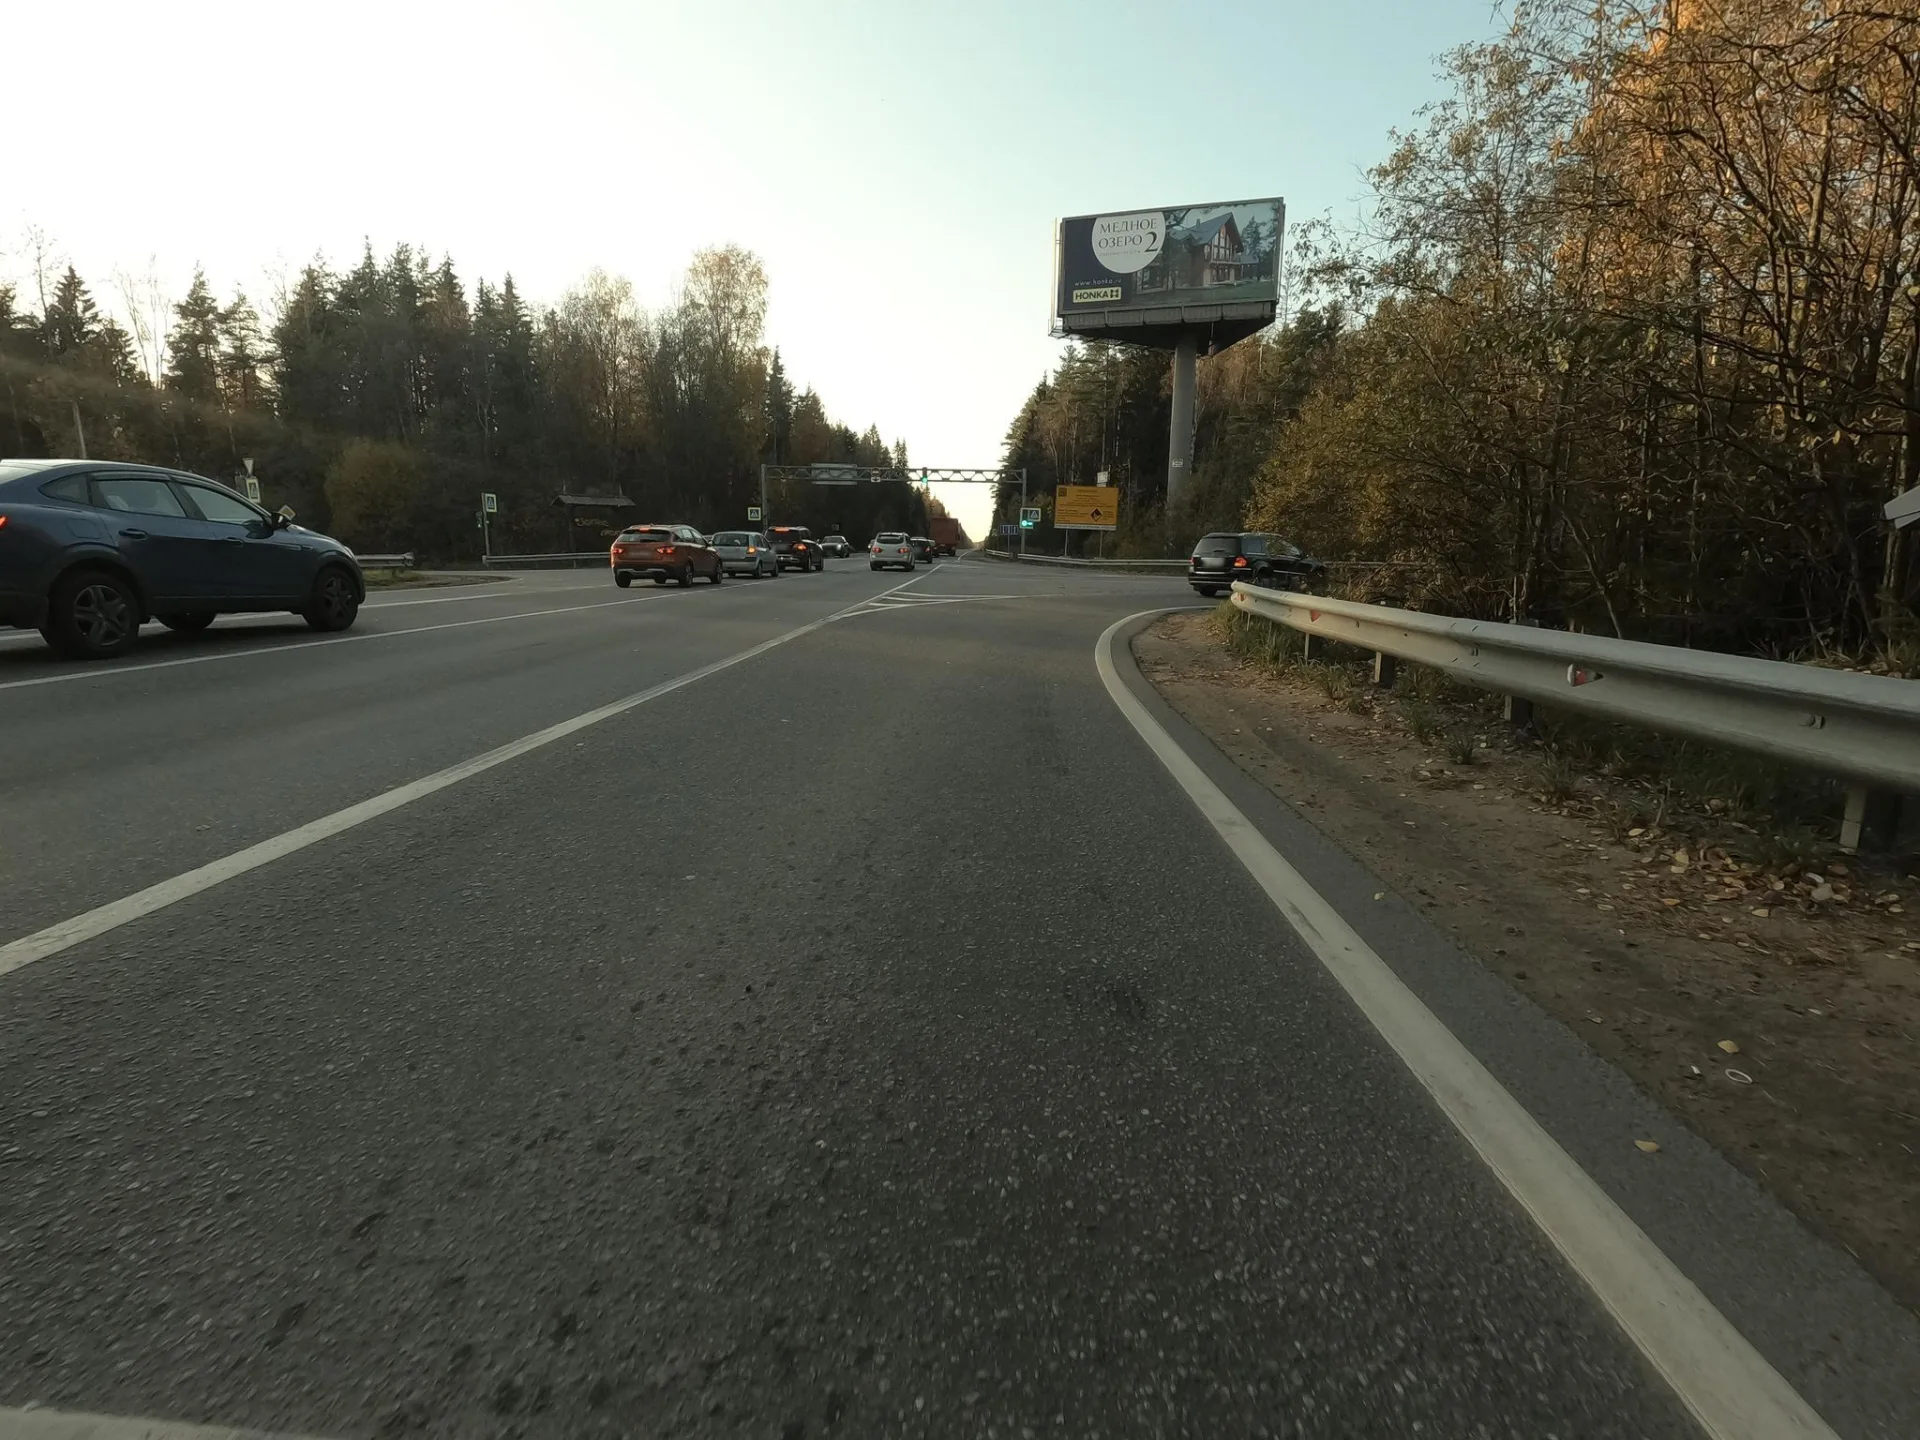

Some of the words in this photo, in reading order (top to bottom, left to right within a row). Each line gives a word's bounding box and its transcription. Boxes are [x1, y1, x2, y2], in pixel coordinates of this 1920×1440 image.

[1099, 218, 1158, 233] МЕДНОЕ
[1098, 235, 1143, 249] ОЗЕРО
[1144, 231, 1159, 253] 2
[1075, 290, 1109, 301] HONKA
